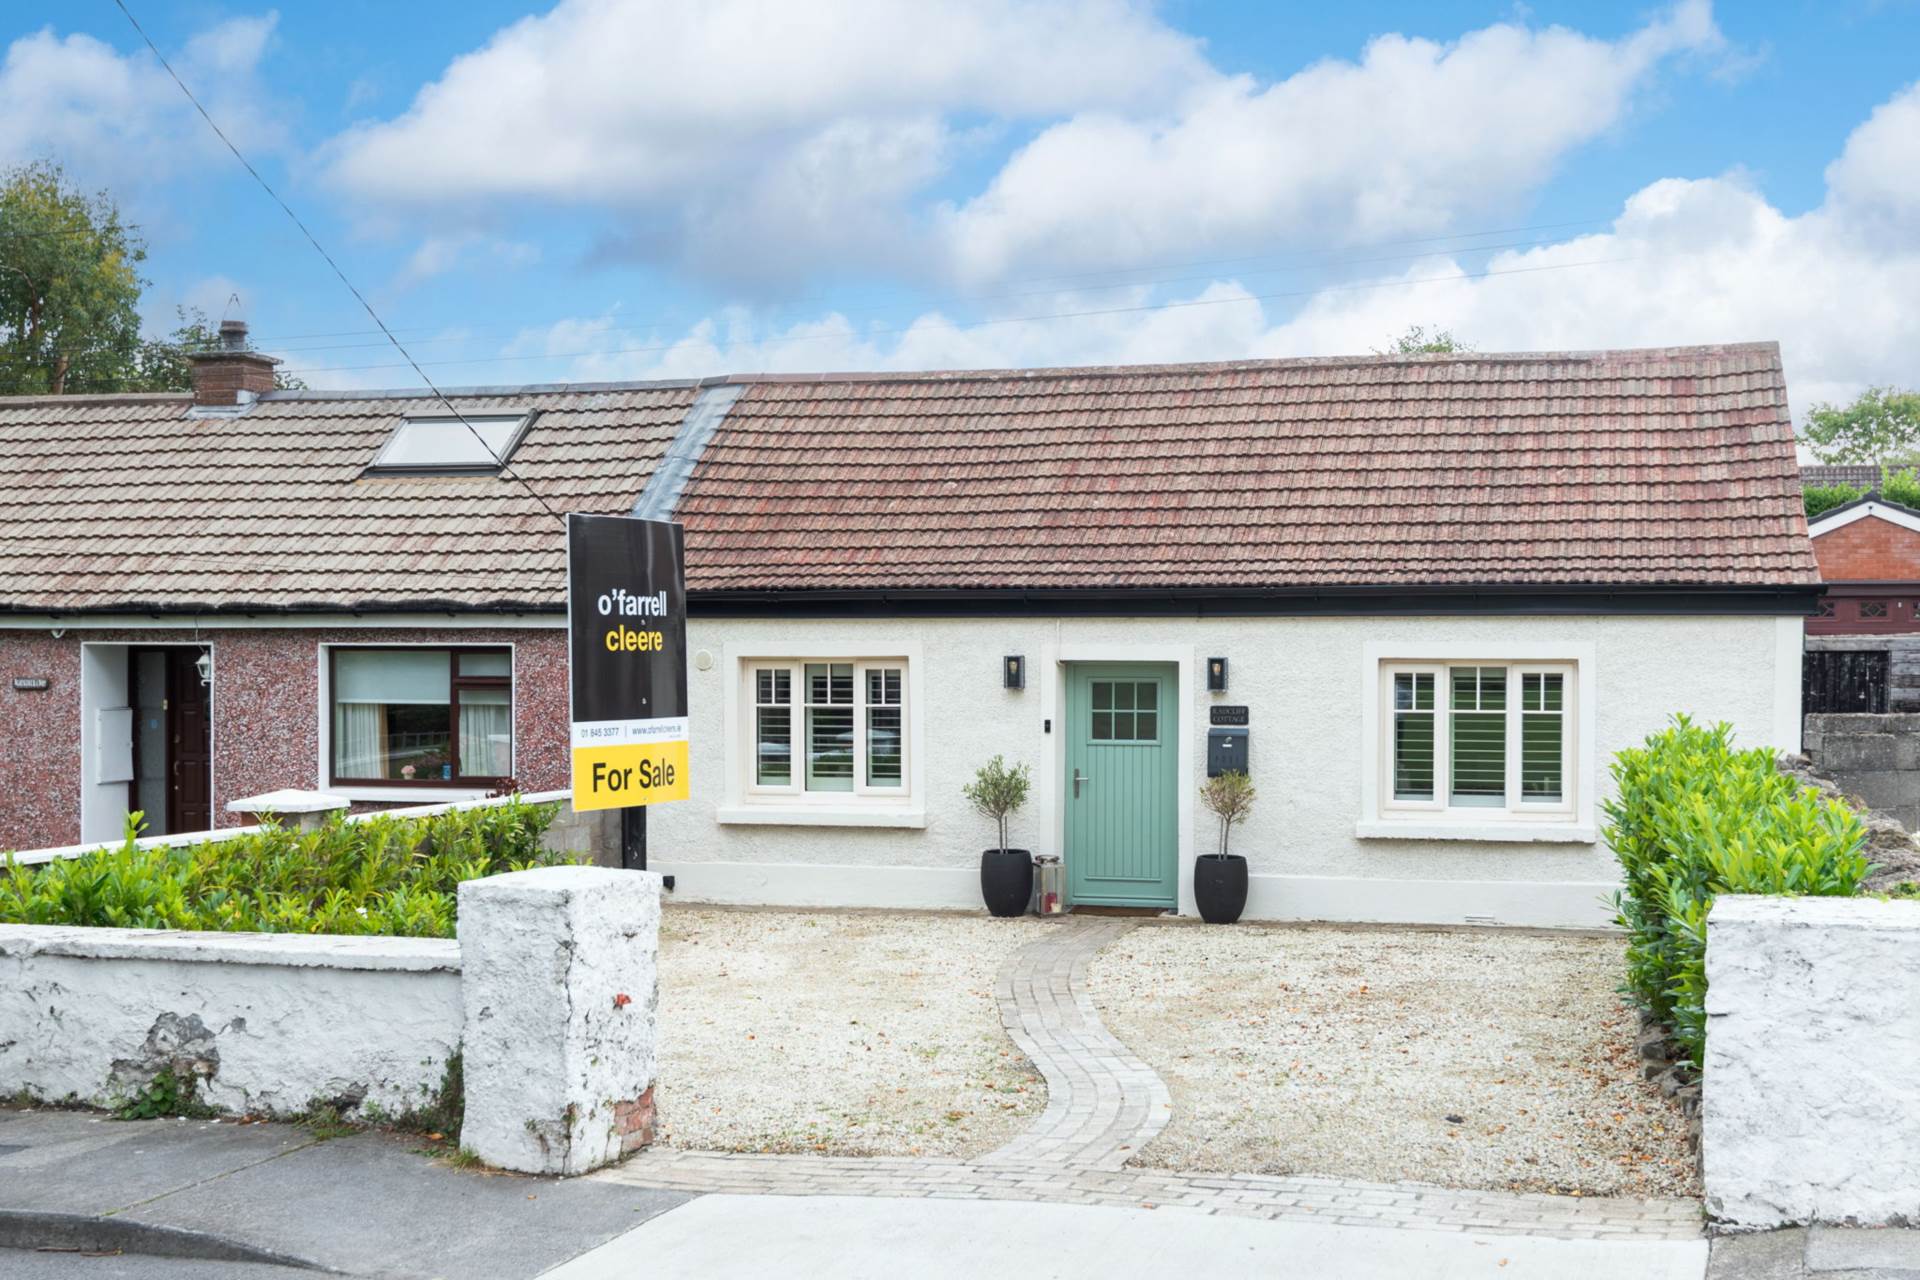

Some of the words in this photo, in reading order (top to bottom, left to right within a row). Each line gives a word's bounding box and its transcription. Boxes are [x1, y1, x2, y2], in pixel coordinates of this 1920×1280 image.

[598, 588, 667, 616] o'farrell
[606, 624, 663, 652] cleere
[581, 728, 588, 738] 01
[603, 727, 619, 737] 3377
[593, 762, 632, 792] For
[639, 757, 675, 789] Sale
